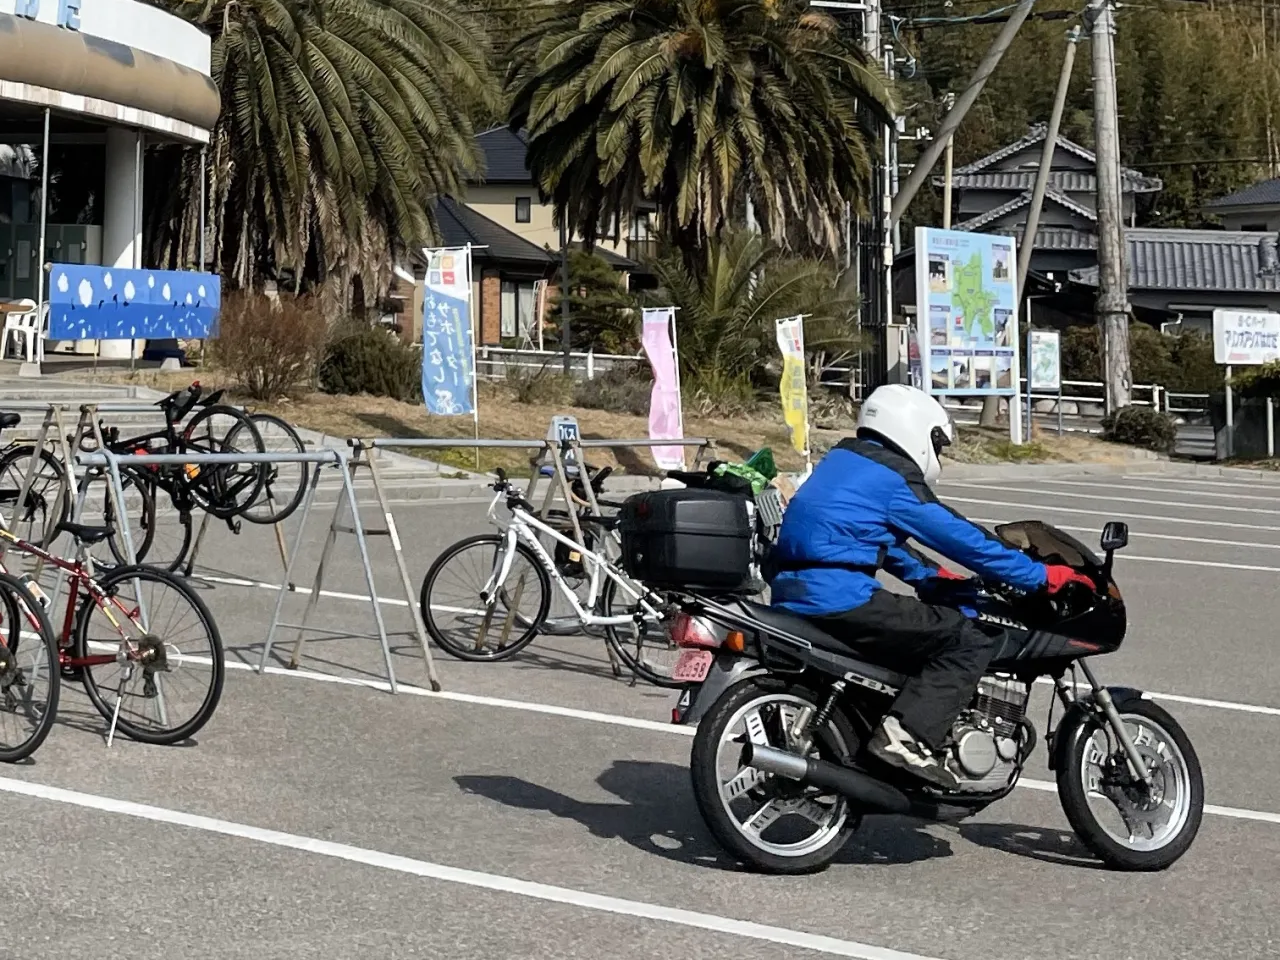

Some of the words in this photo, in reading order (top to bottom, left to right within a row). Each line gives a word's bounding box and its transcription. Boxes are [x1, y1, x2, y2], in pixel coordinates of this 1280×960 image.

[425, 294, 444, 384] おもてなし
[438, 302, 458, 386] サポーター
